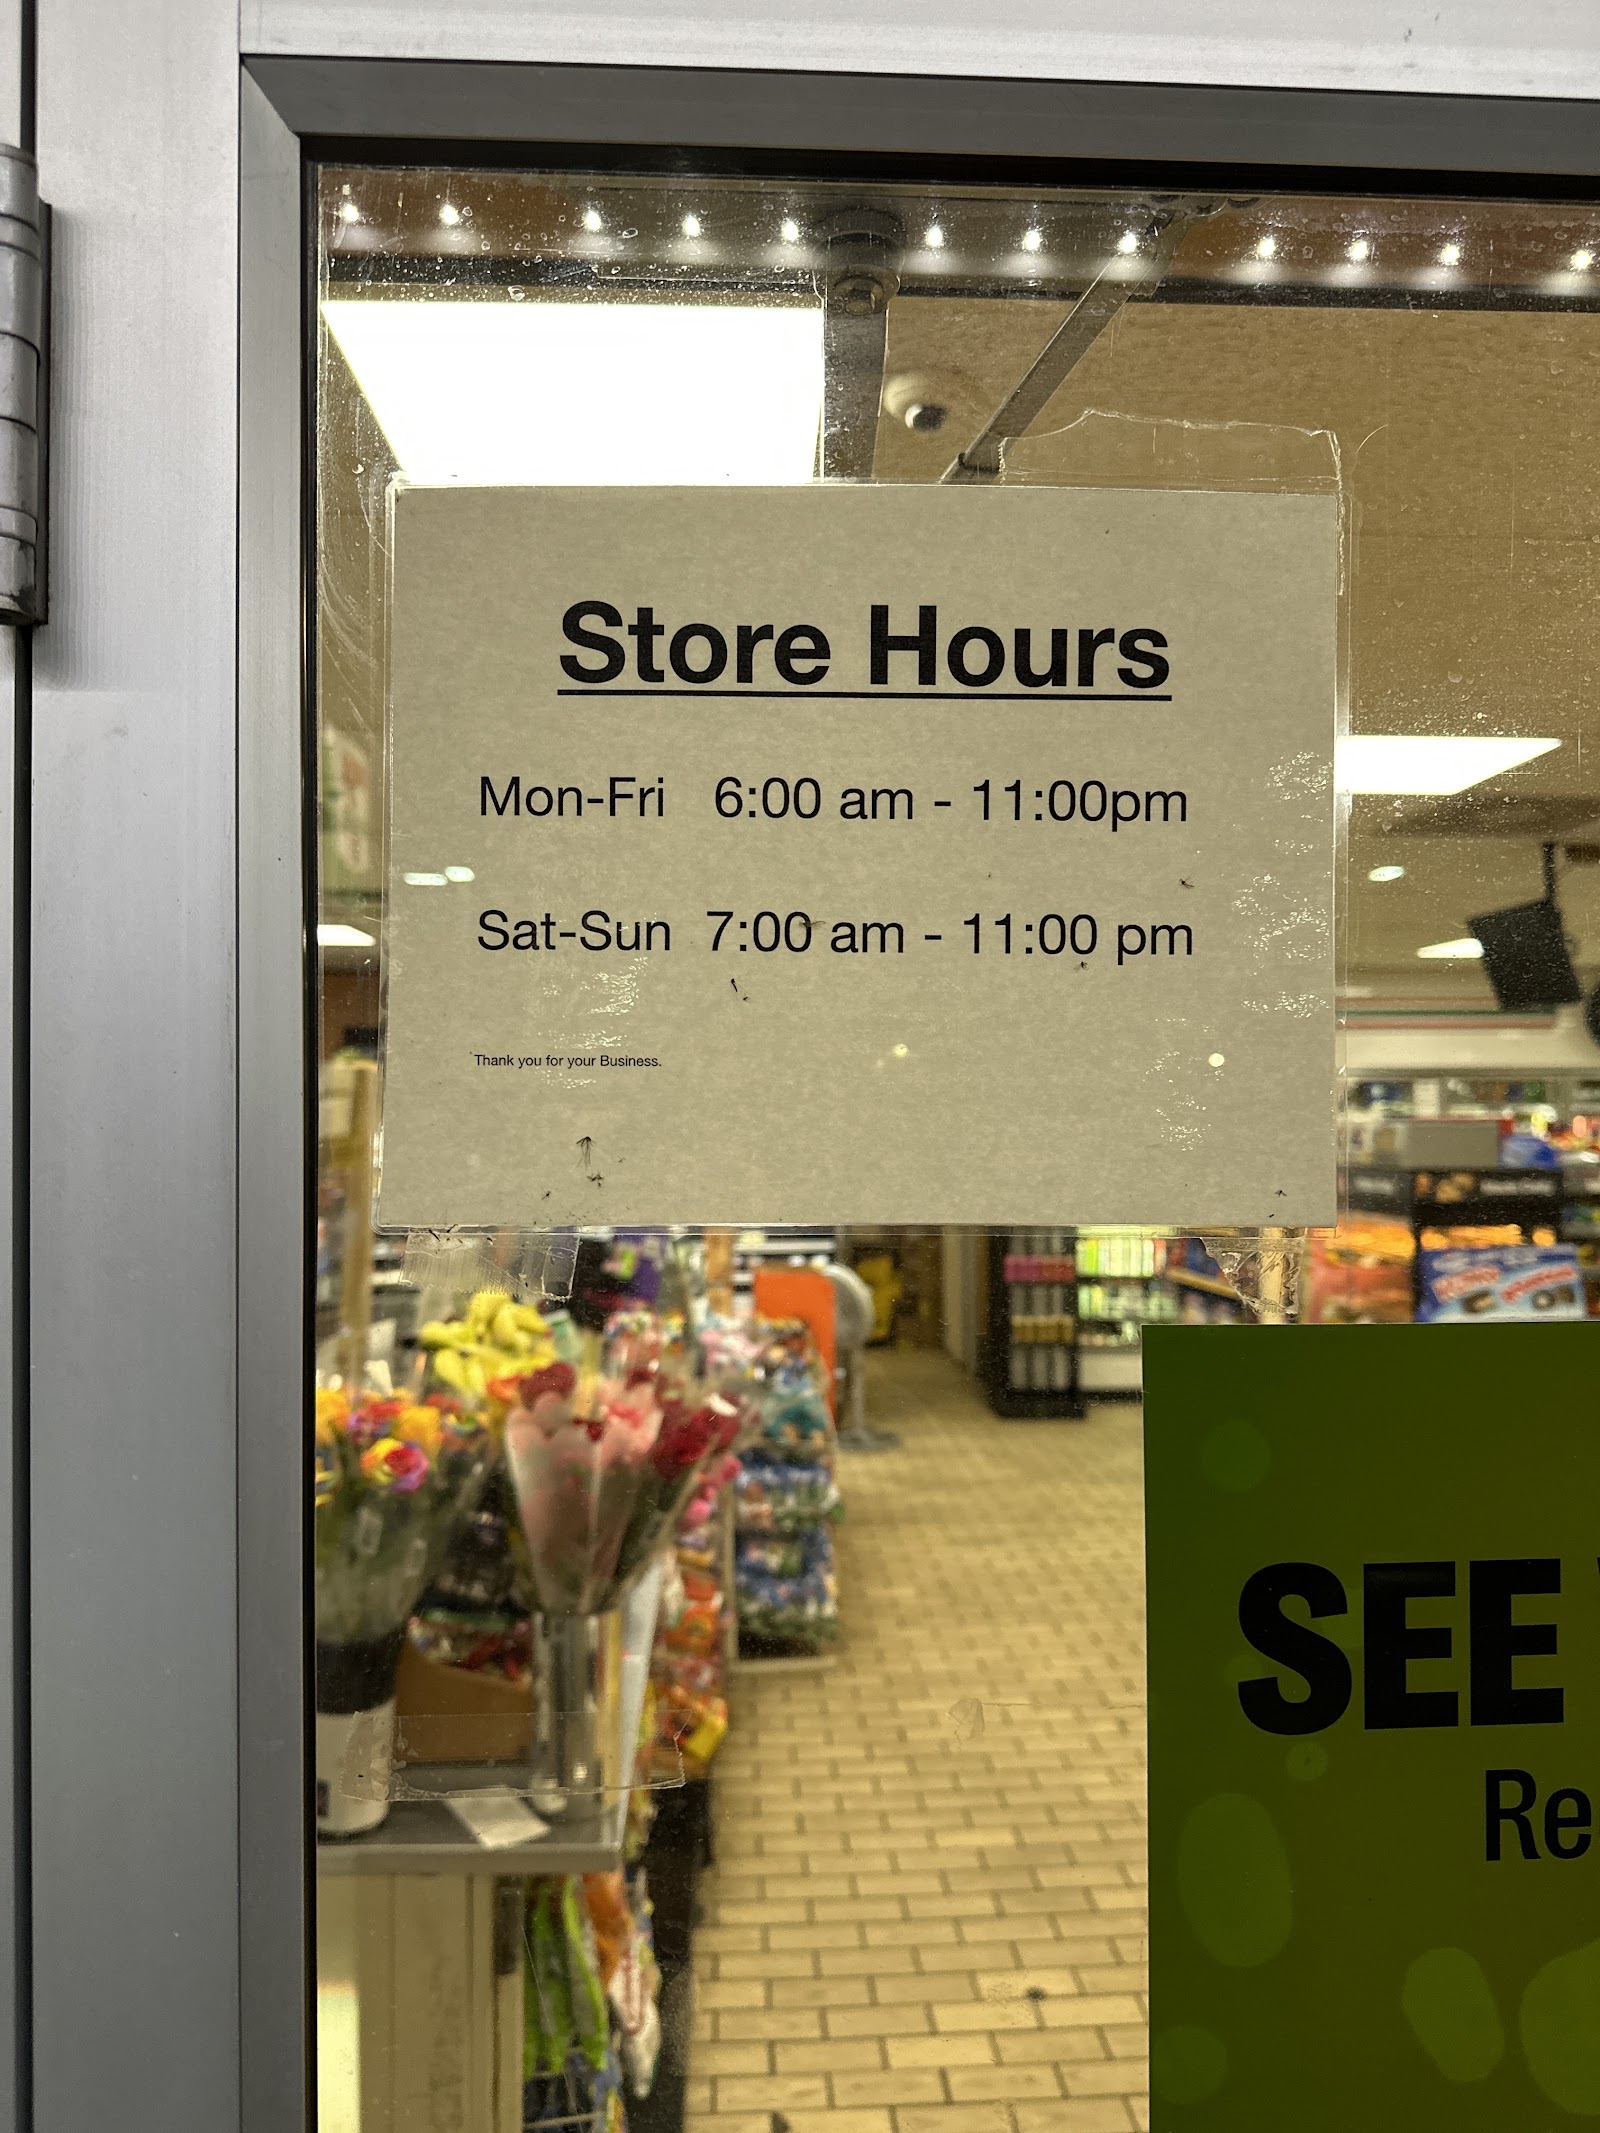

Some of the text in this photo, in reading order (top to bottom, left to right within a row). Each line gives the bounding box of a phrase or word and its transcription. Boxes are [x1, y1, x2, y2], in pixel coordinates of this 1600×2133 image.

[560, 600, 1170, 689] Store Hours
[480, 776, 664, 817] Mon-Fri
[715, 776, 821, 819] 6:00
[839, 788, 913, 820] am
[973, 779, 1187, 833] 11:00pm
[477, 909, 671, 952] Sat-Sun
[706, 910, 816, 953] 7:00
[830, 921, 904, 954] am
[963, 912, 1098, 955] 11:00
[1117, 924, 1193, 966] pm
[474, 1054, 662, 1070] Thank you for your Business.
[1237, 1557, 1565, 1736] SEE
[1485, 1768, 1600, 1862] Re
